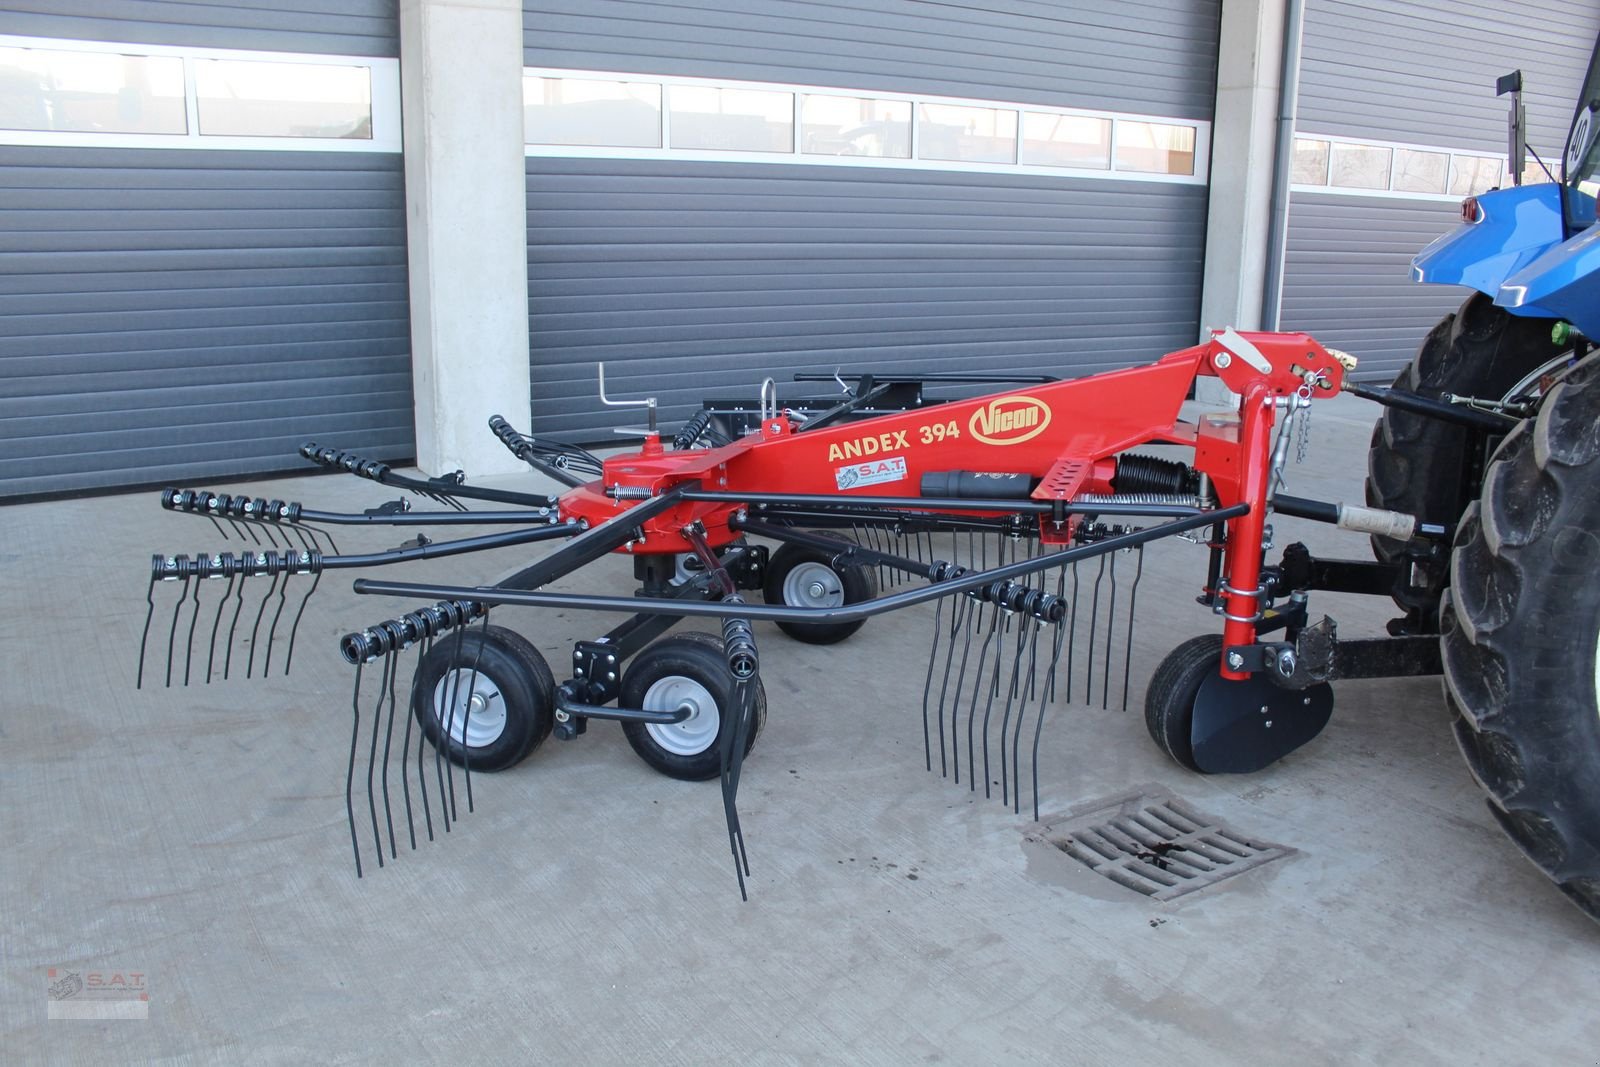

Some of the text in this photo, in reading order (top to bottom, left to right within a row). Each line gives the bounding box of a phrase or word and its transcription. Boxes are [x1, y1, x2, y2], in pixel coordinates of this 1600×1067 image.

[1571, 120, 1587, 161] 40
[971, 399, 1045, 439] Vicon
[828, 420, 960, 462] ANDEX 394
